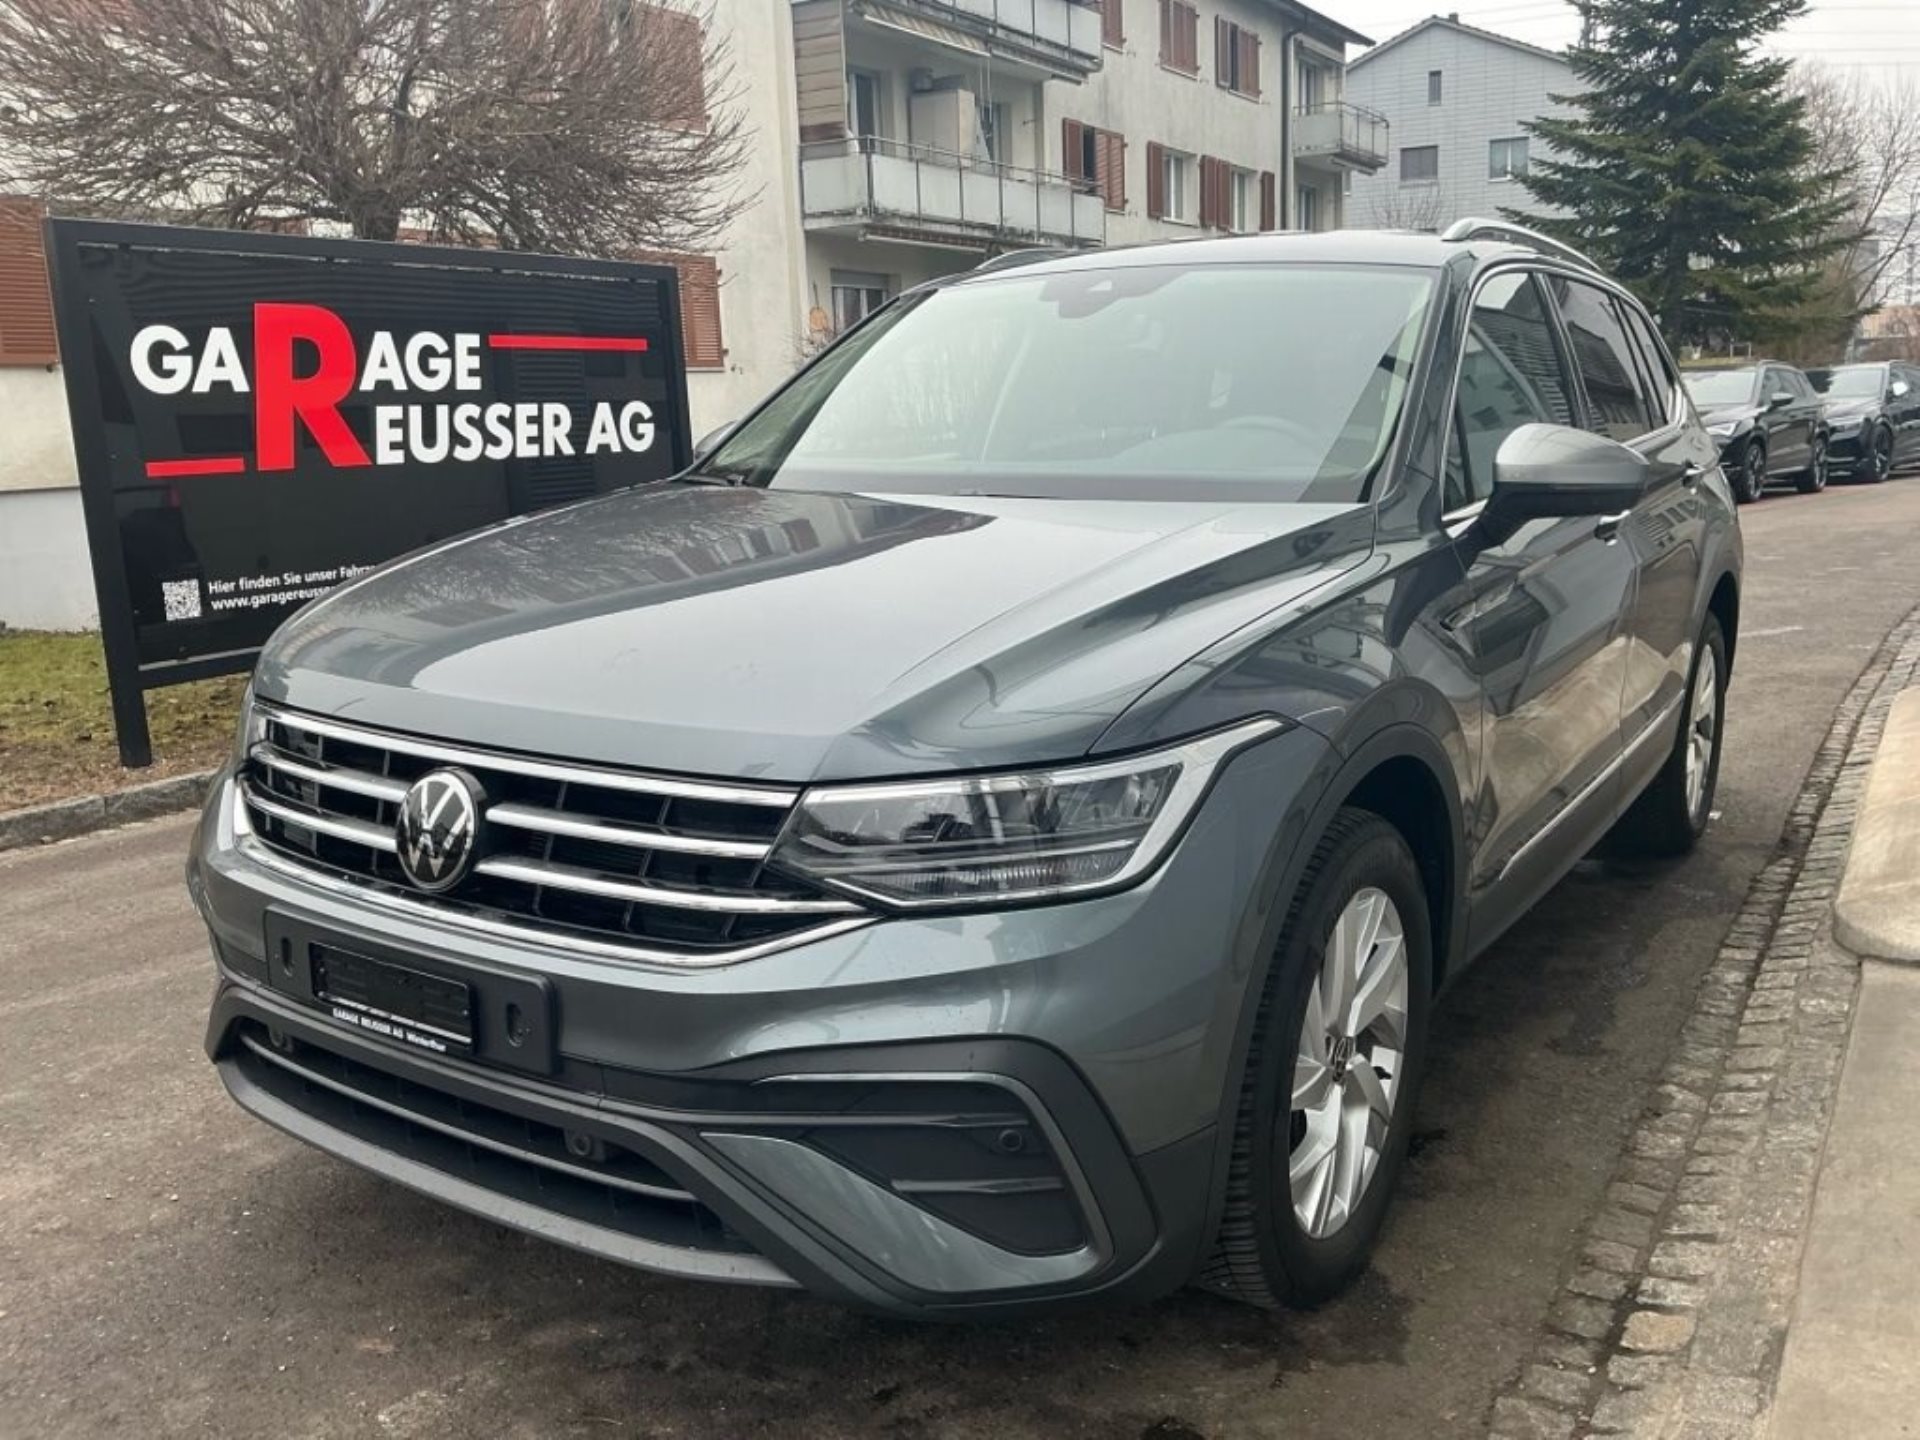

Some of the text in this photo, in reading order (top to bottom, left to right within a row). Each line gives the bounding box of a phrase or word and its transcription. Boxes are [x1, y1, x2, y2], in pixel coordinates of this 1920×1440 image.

[130, 302, 482, 471] GARAGE
[585, 401, 656, 455] AG
[208, 564, 377, 595] Hier finden Sie unser Fahr
